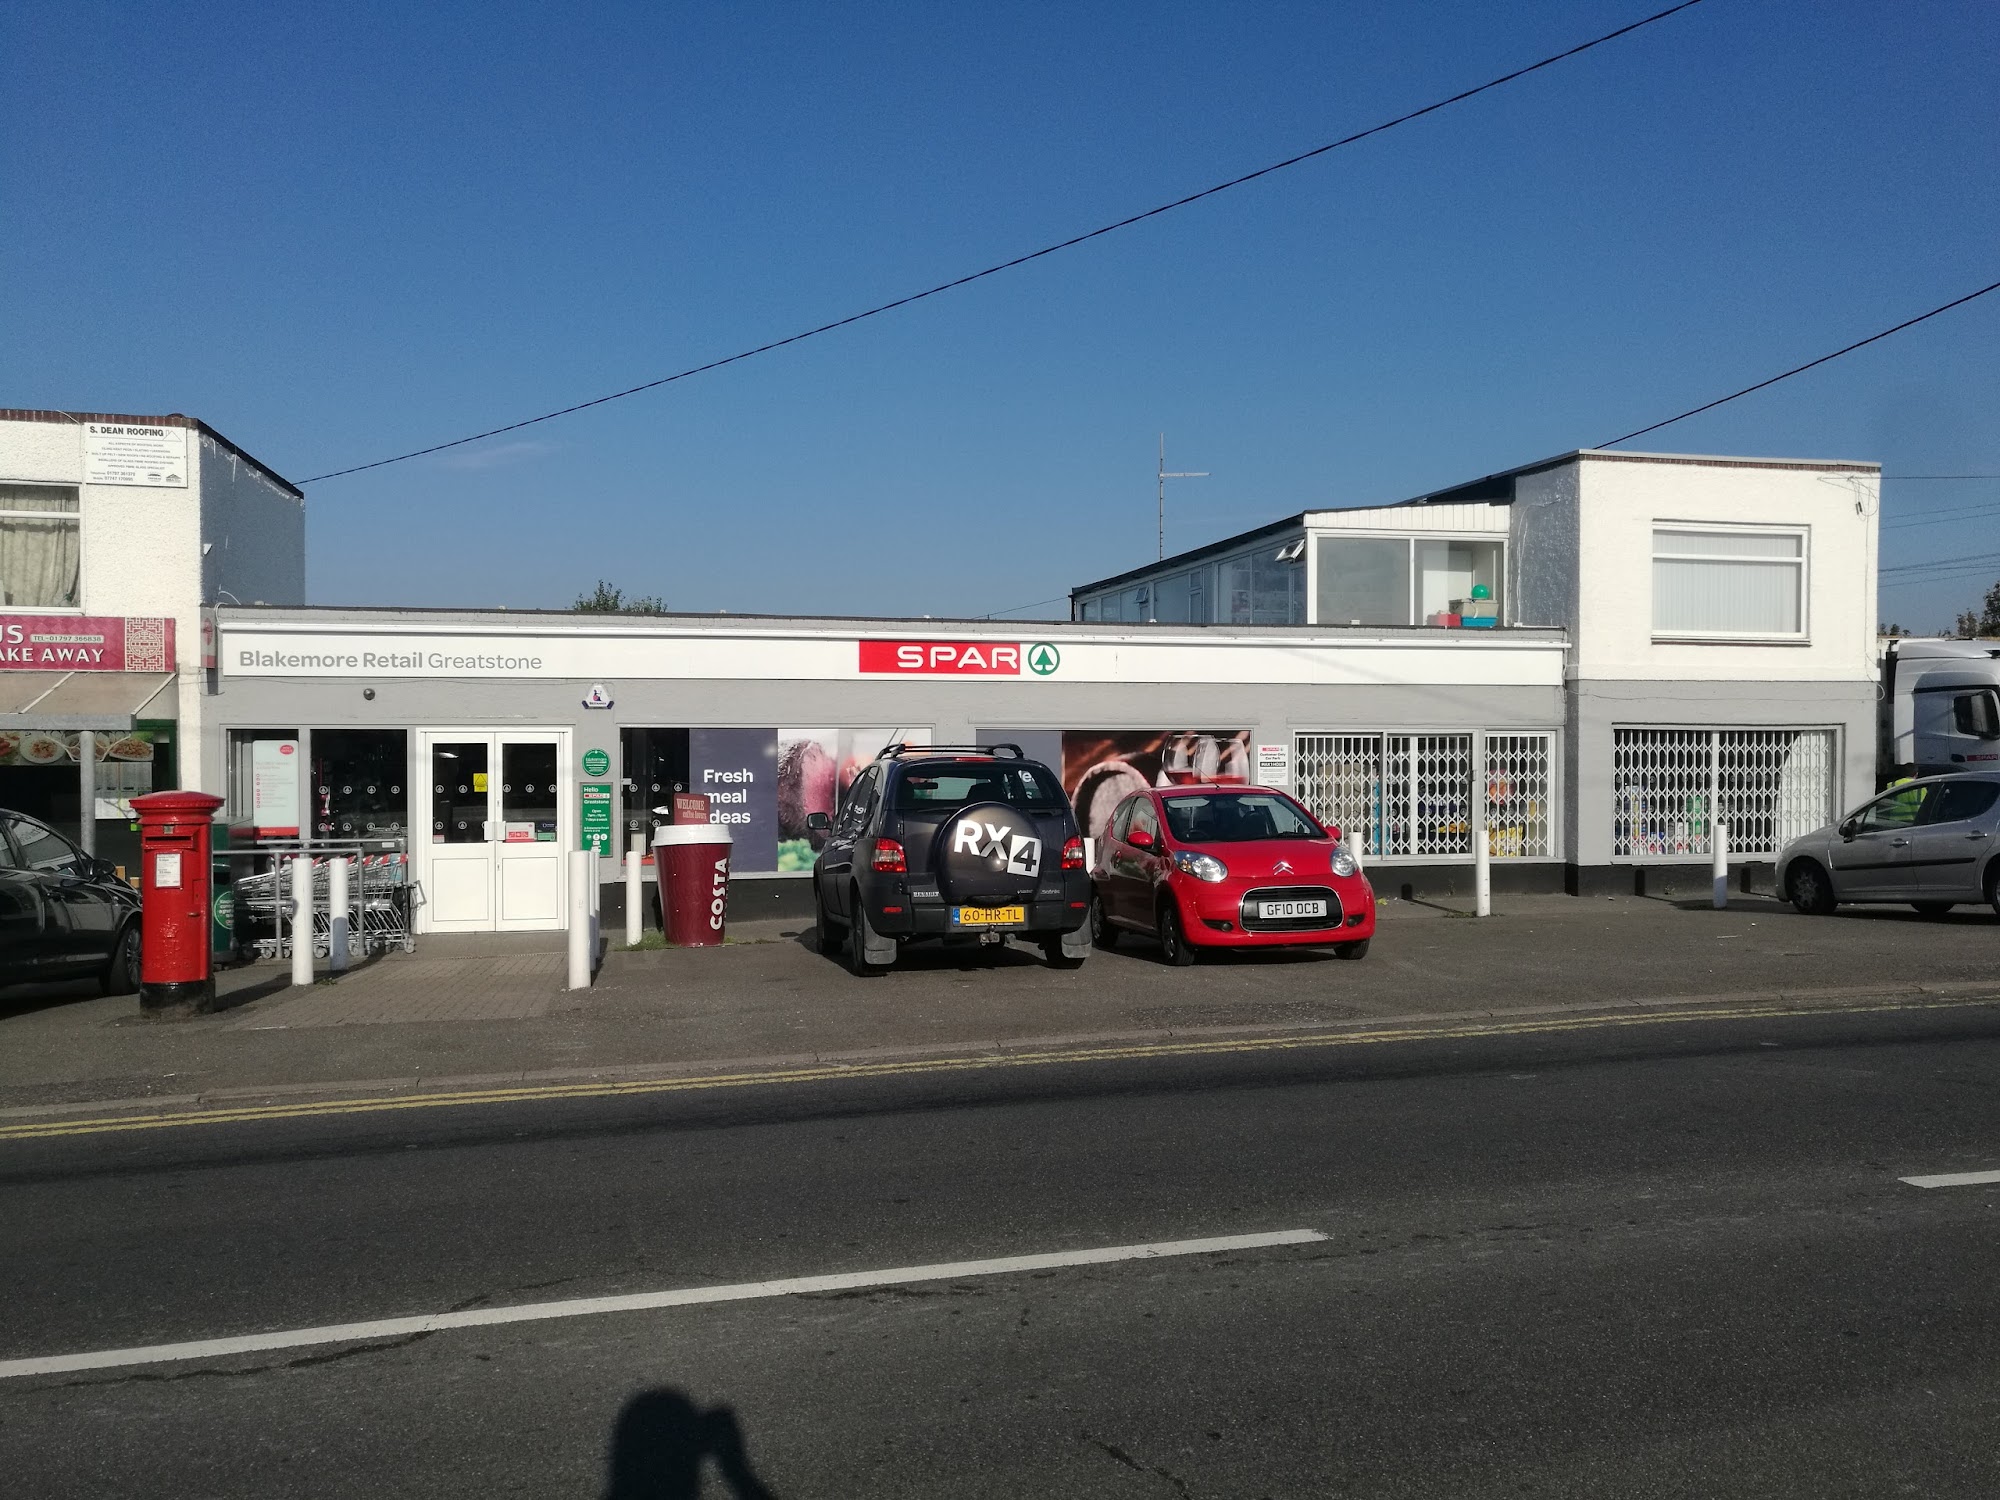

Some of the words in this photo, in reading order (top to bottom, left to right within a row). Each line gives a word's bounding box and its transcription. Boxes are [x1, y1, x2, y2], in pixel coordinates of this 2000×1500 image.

[127, 428, 164, 437] ROOFING
[41, 648, 104, 662] AWAY
[239, 651, 358, 668] Blakemore
[363, 652, 423, 668] Retail
[428, 653, 542, 669] Greatstone
[897, 646, 1018, 669] SPAR
[703, 768, 754, 783] Fresh
[676, 799, 704, 810] WELCOME
[695, 811, 707, 821] lovers
[954, 820, 1037, 872] RX4
[710, 858, 727, 930] COSTA
[963, 909, 1020, 921] 60-HR-TL
[1267, 904, 1293, 915] GF10
[1297, 903, 1318, 914] OCB
